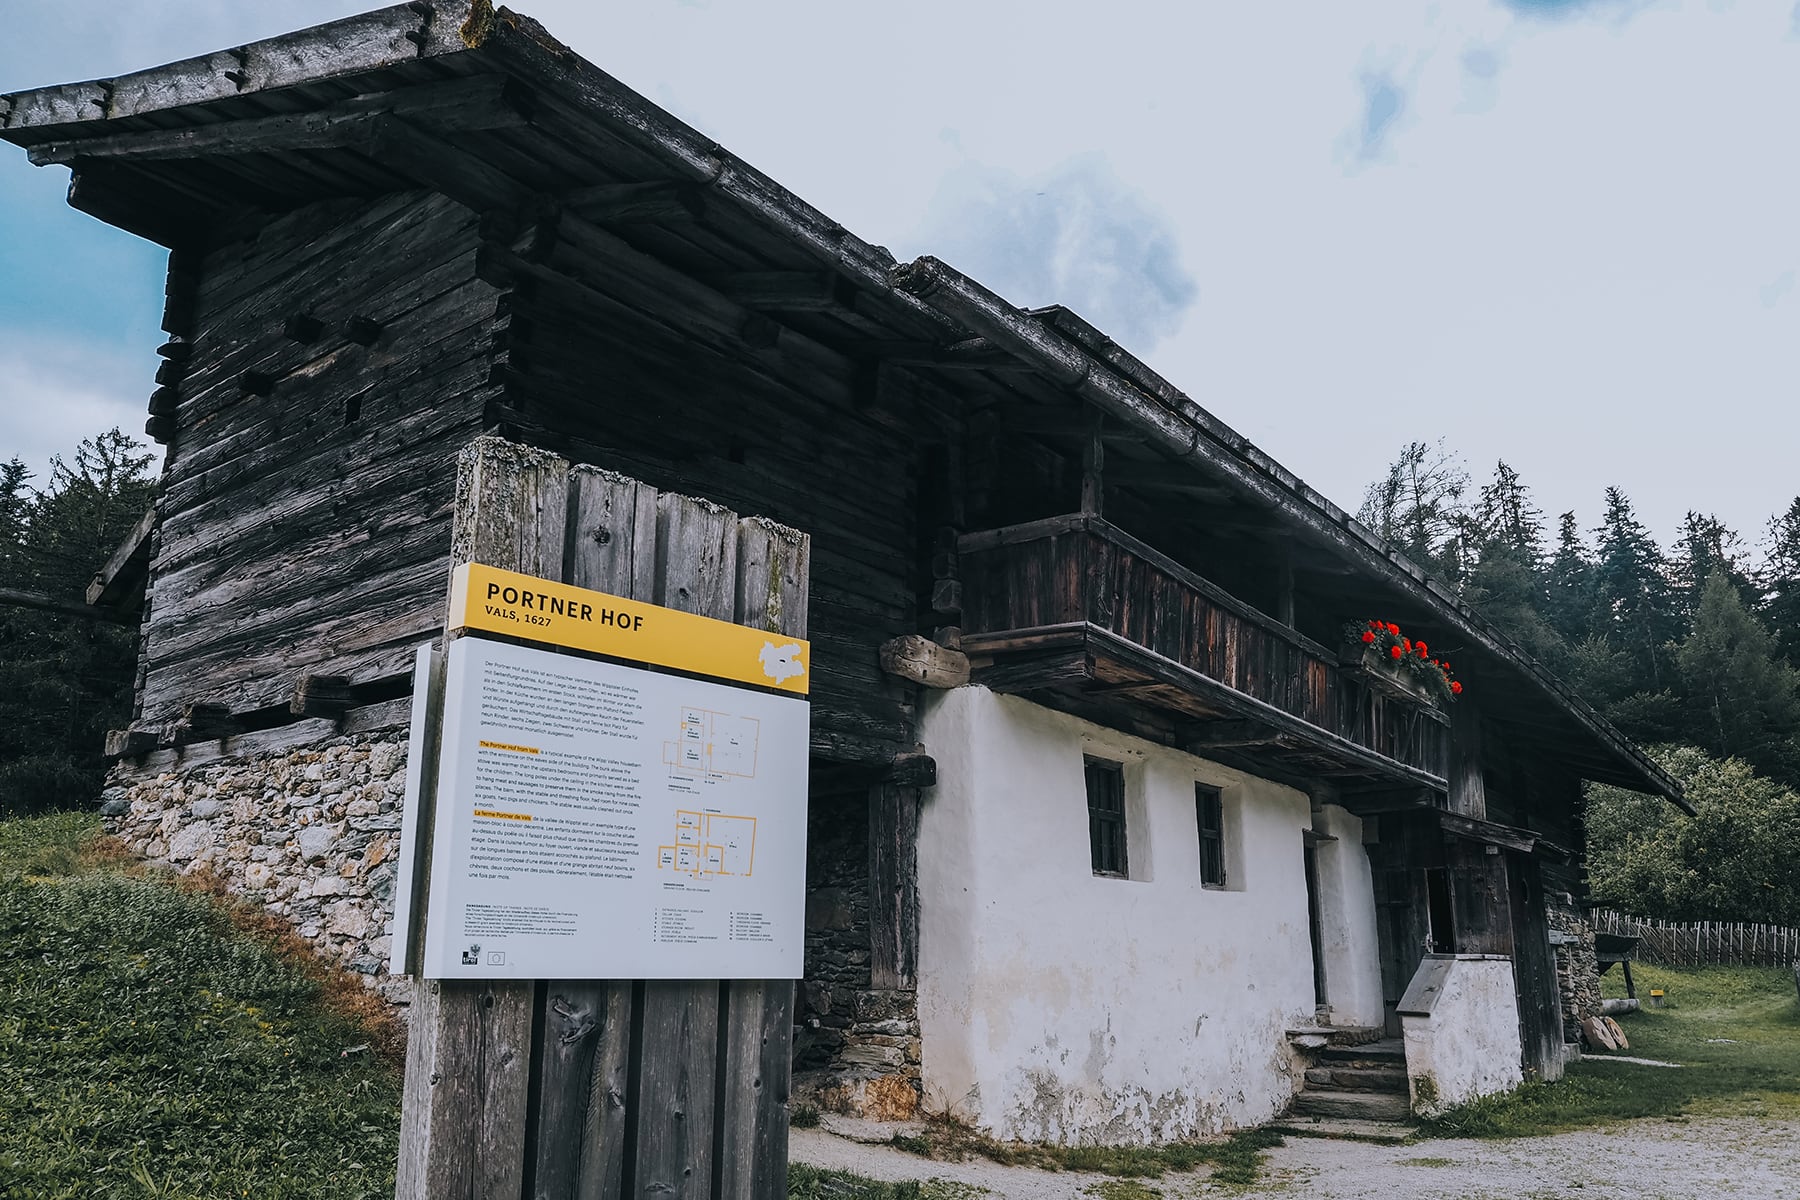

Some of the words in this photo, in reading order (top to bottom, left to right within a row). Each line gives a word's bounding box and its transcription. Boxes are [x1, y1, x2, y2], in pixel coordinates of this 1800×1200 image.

[485, 605, 520, 622] VALS,
[524, 614, 552, 627] 1627
[487, 582, 592, 622] PORTNER
[601, 608, 644, 632] HOF
